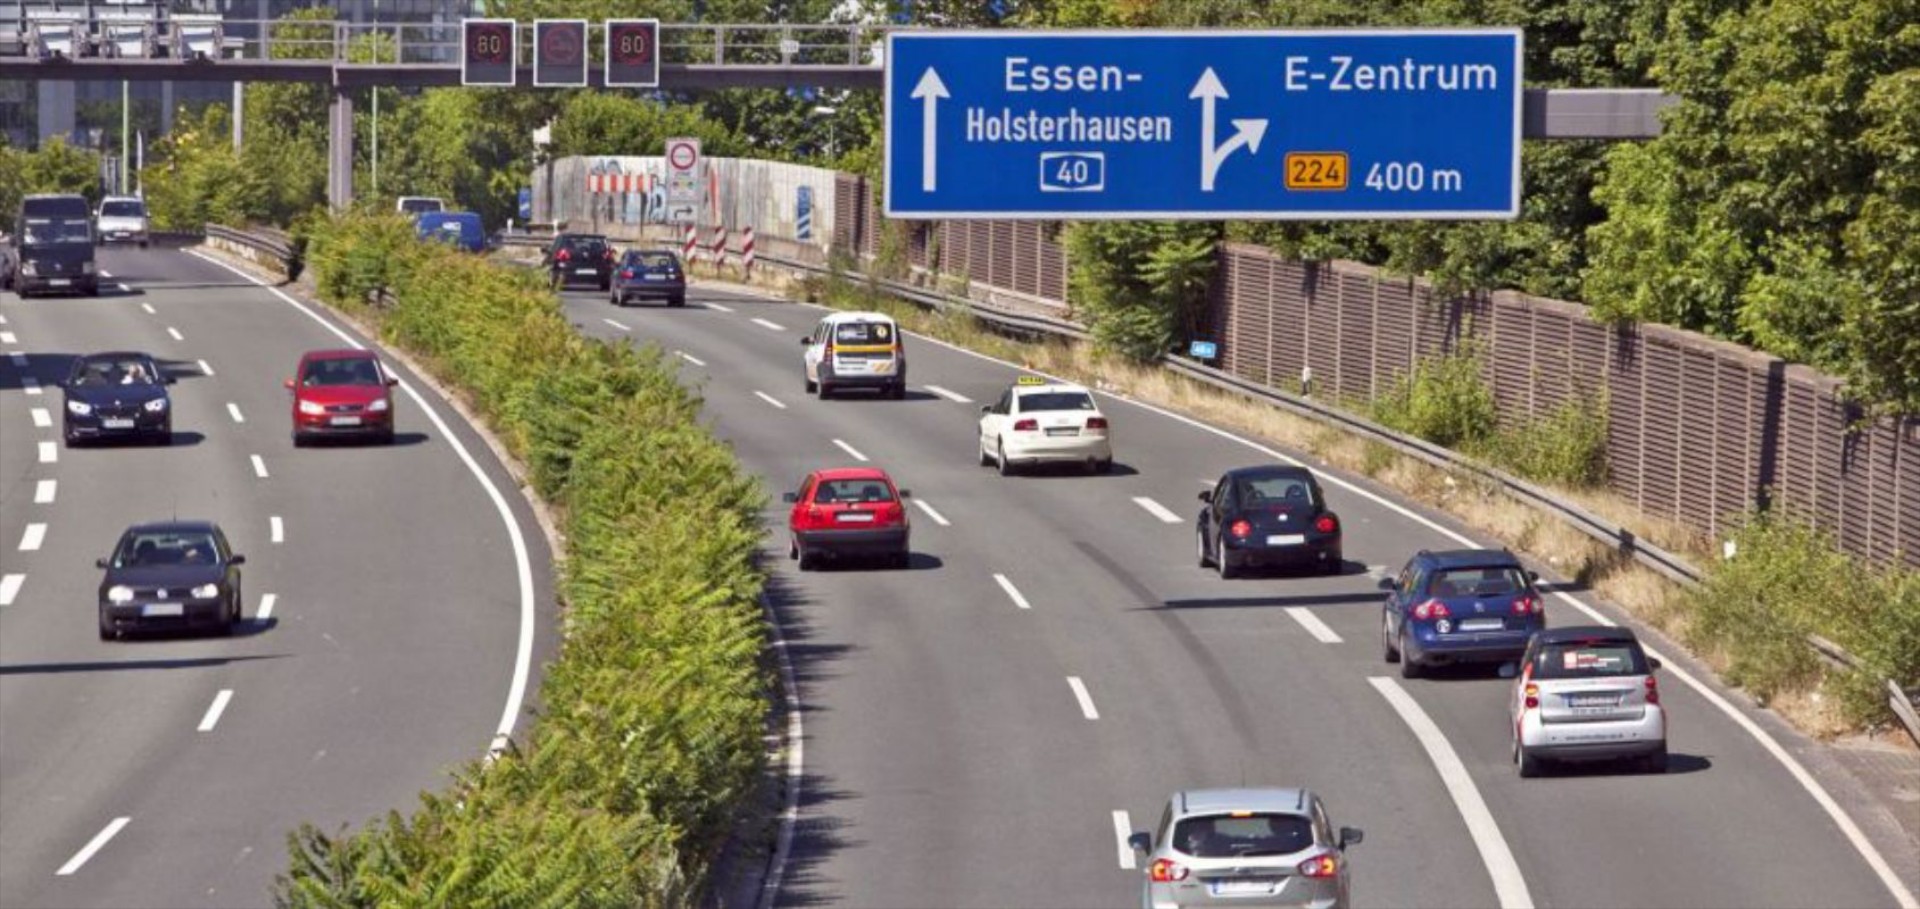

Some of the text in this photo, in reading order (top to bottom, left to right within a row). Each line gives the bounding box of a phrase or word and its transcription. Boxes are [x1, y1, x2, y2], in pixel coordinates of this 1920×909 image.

[1005, 57, 1142, 91] Essen-
[1286, 56, 1498, 90] E-Zentrum
[967, 108, 1171, 141] Holsterhausen
[1057, 160, 1088, 183] 40
[1294, 161, 1340, 184] 224
[1365, 162, 1461, 191] 400 m
